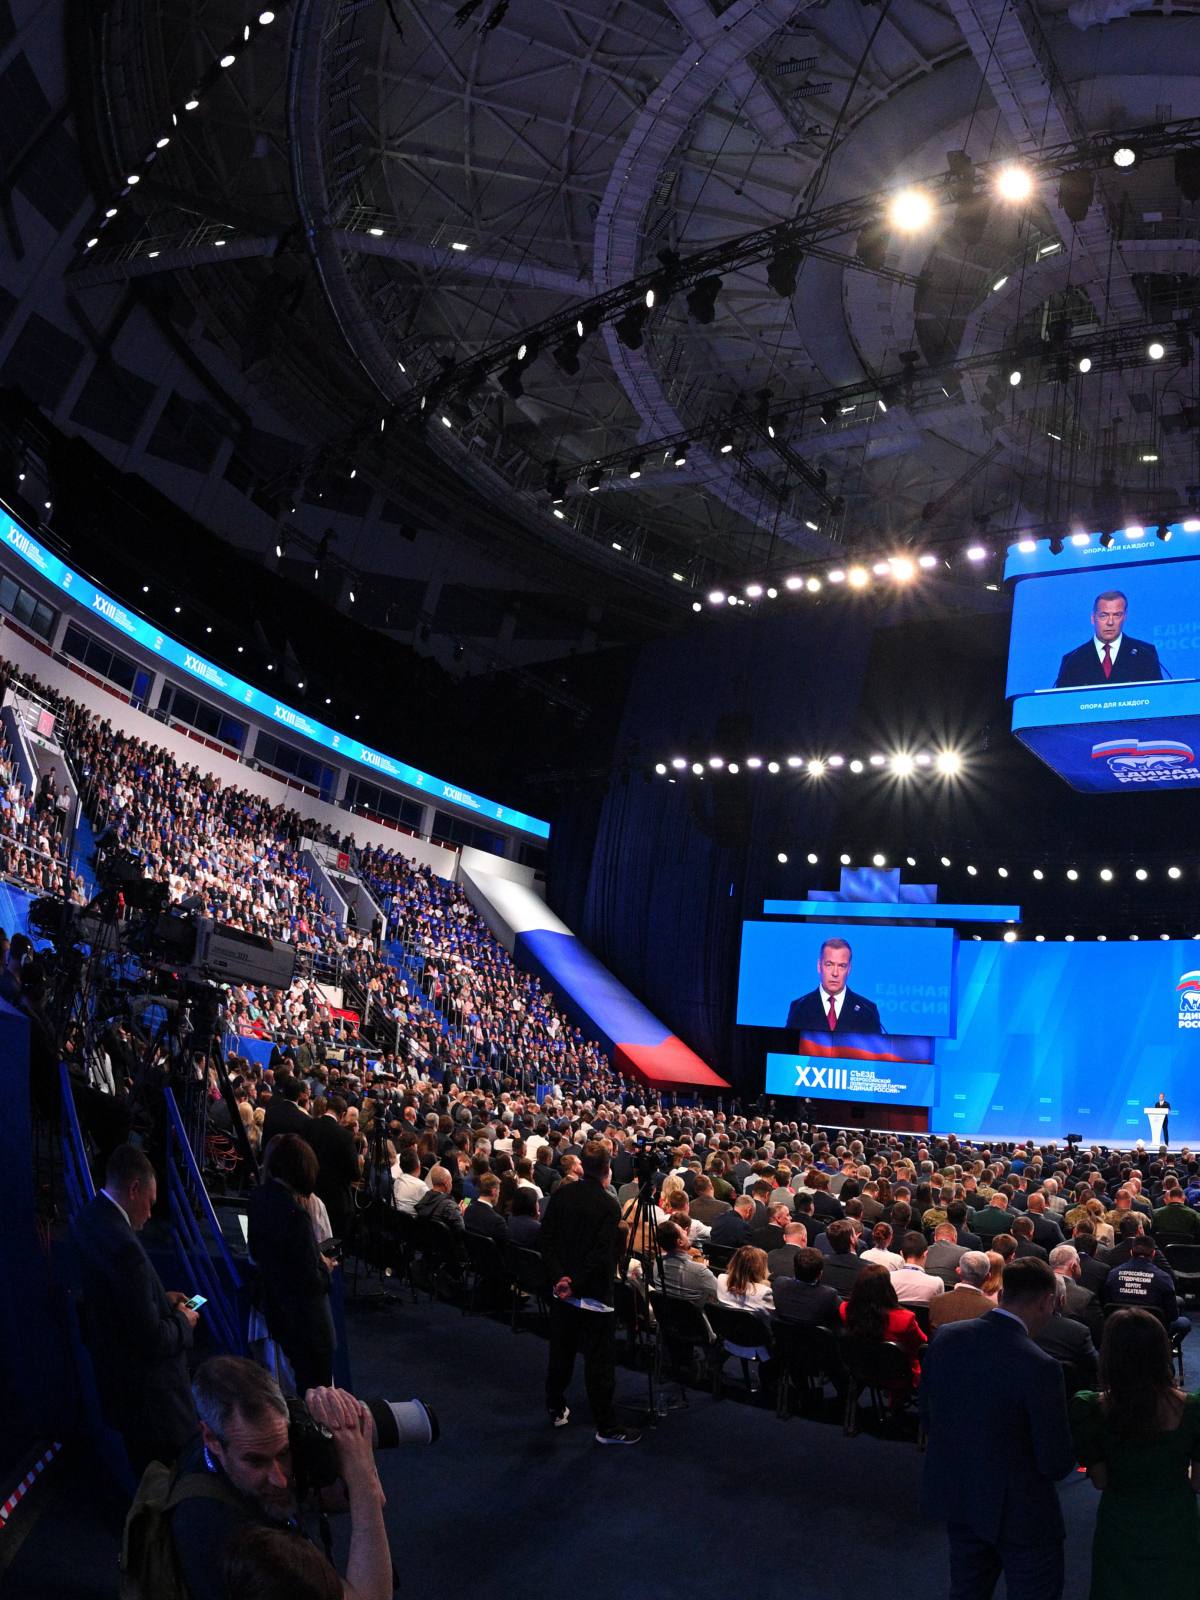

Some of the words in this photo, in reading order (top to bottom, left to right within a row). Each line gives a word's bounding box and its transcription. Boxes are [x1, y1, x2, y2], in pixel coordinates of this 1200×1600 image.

[7, 525, 30, 552] XXIII
[1122, 541, 1155, 550] КАЖДОГО
[92, 594, 117, 620] XXIII
[183, 654, 207, 675] XXIII
[1118, 699, 1150, 707] КАЖДОГО
[274, 705, 296, 726] XXIII
[360, 749, 381, 769] XXIII
[1113, 768, 1199, 778] ЕДИНАЯ
[443, 786, 463, 804] XXIII
[875, 983, 949, 998] ЕДИНАЯ
[876, 1000, 948, 1014] РОССИЯ
[795, 1065, 847, 1090] XXIII
[850, 1070, 875, 1079] СЪЕЗД
